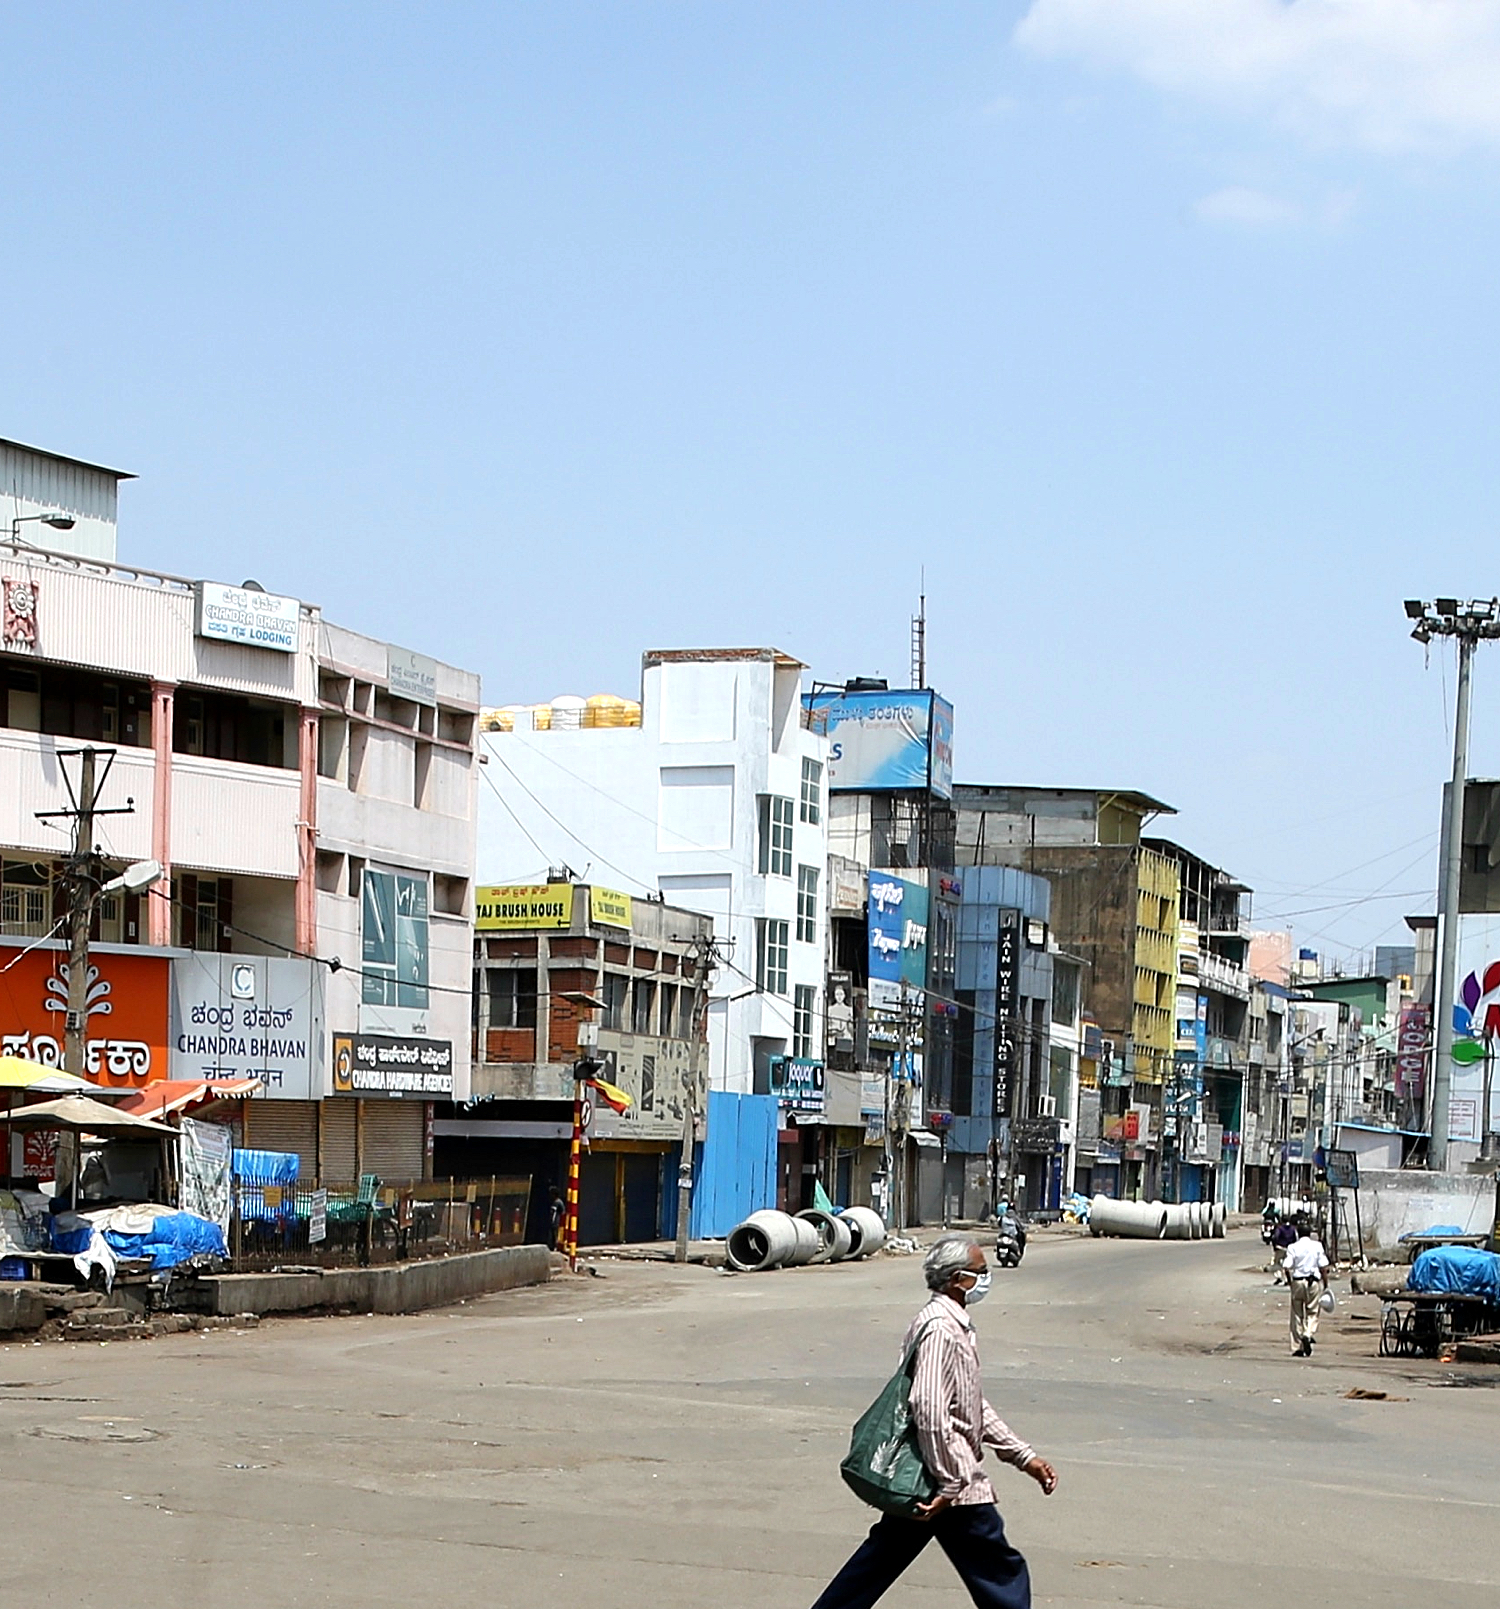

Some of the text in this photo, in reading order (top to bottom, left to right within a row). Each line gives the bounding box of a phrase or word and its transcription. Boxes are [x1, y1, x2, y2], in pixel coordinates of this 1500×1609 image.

[205, 605, 296, 635] CHANDRA BHAVAN
[250, 626, 292, 646] LODGING
[477, 903, 564, 918] TAJ BRUSH HOUSE
[1001, 933, 1012, 964] JAIN
[999, 970, 1012, 1001] WIRE
[191, 1001, 293, 1034] ಚಂದ್ರ ಭವನ್
[178, 1034, 306, 1059] CHANDRA BHAVAN
[352, 1069, 452, 1092] CHANDRA HARDWARE AGENCIES
[996, 1067, 1007, 1114] STORES
